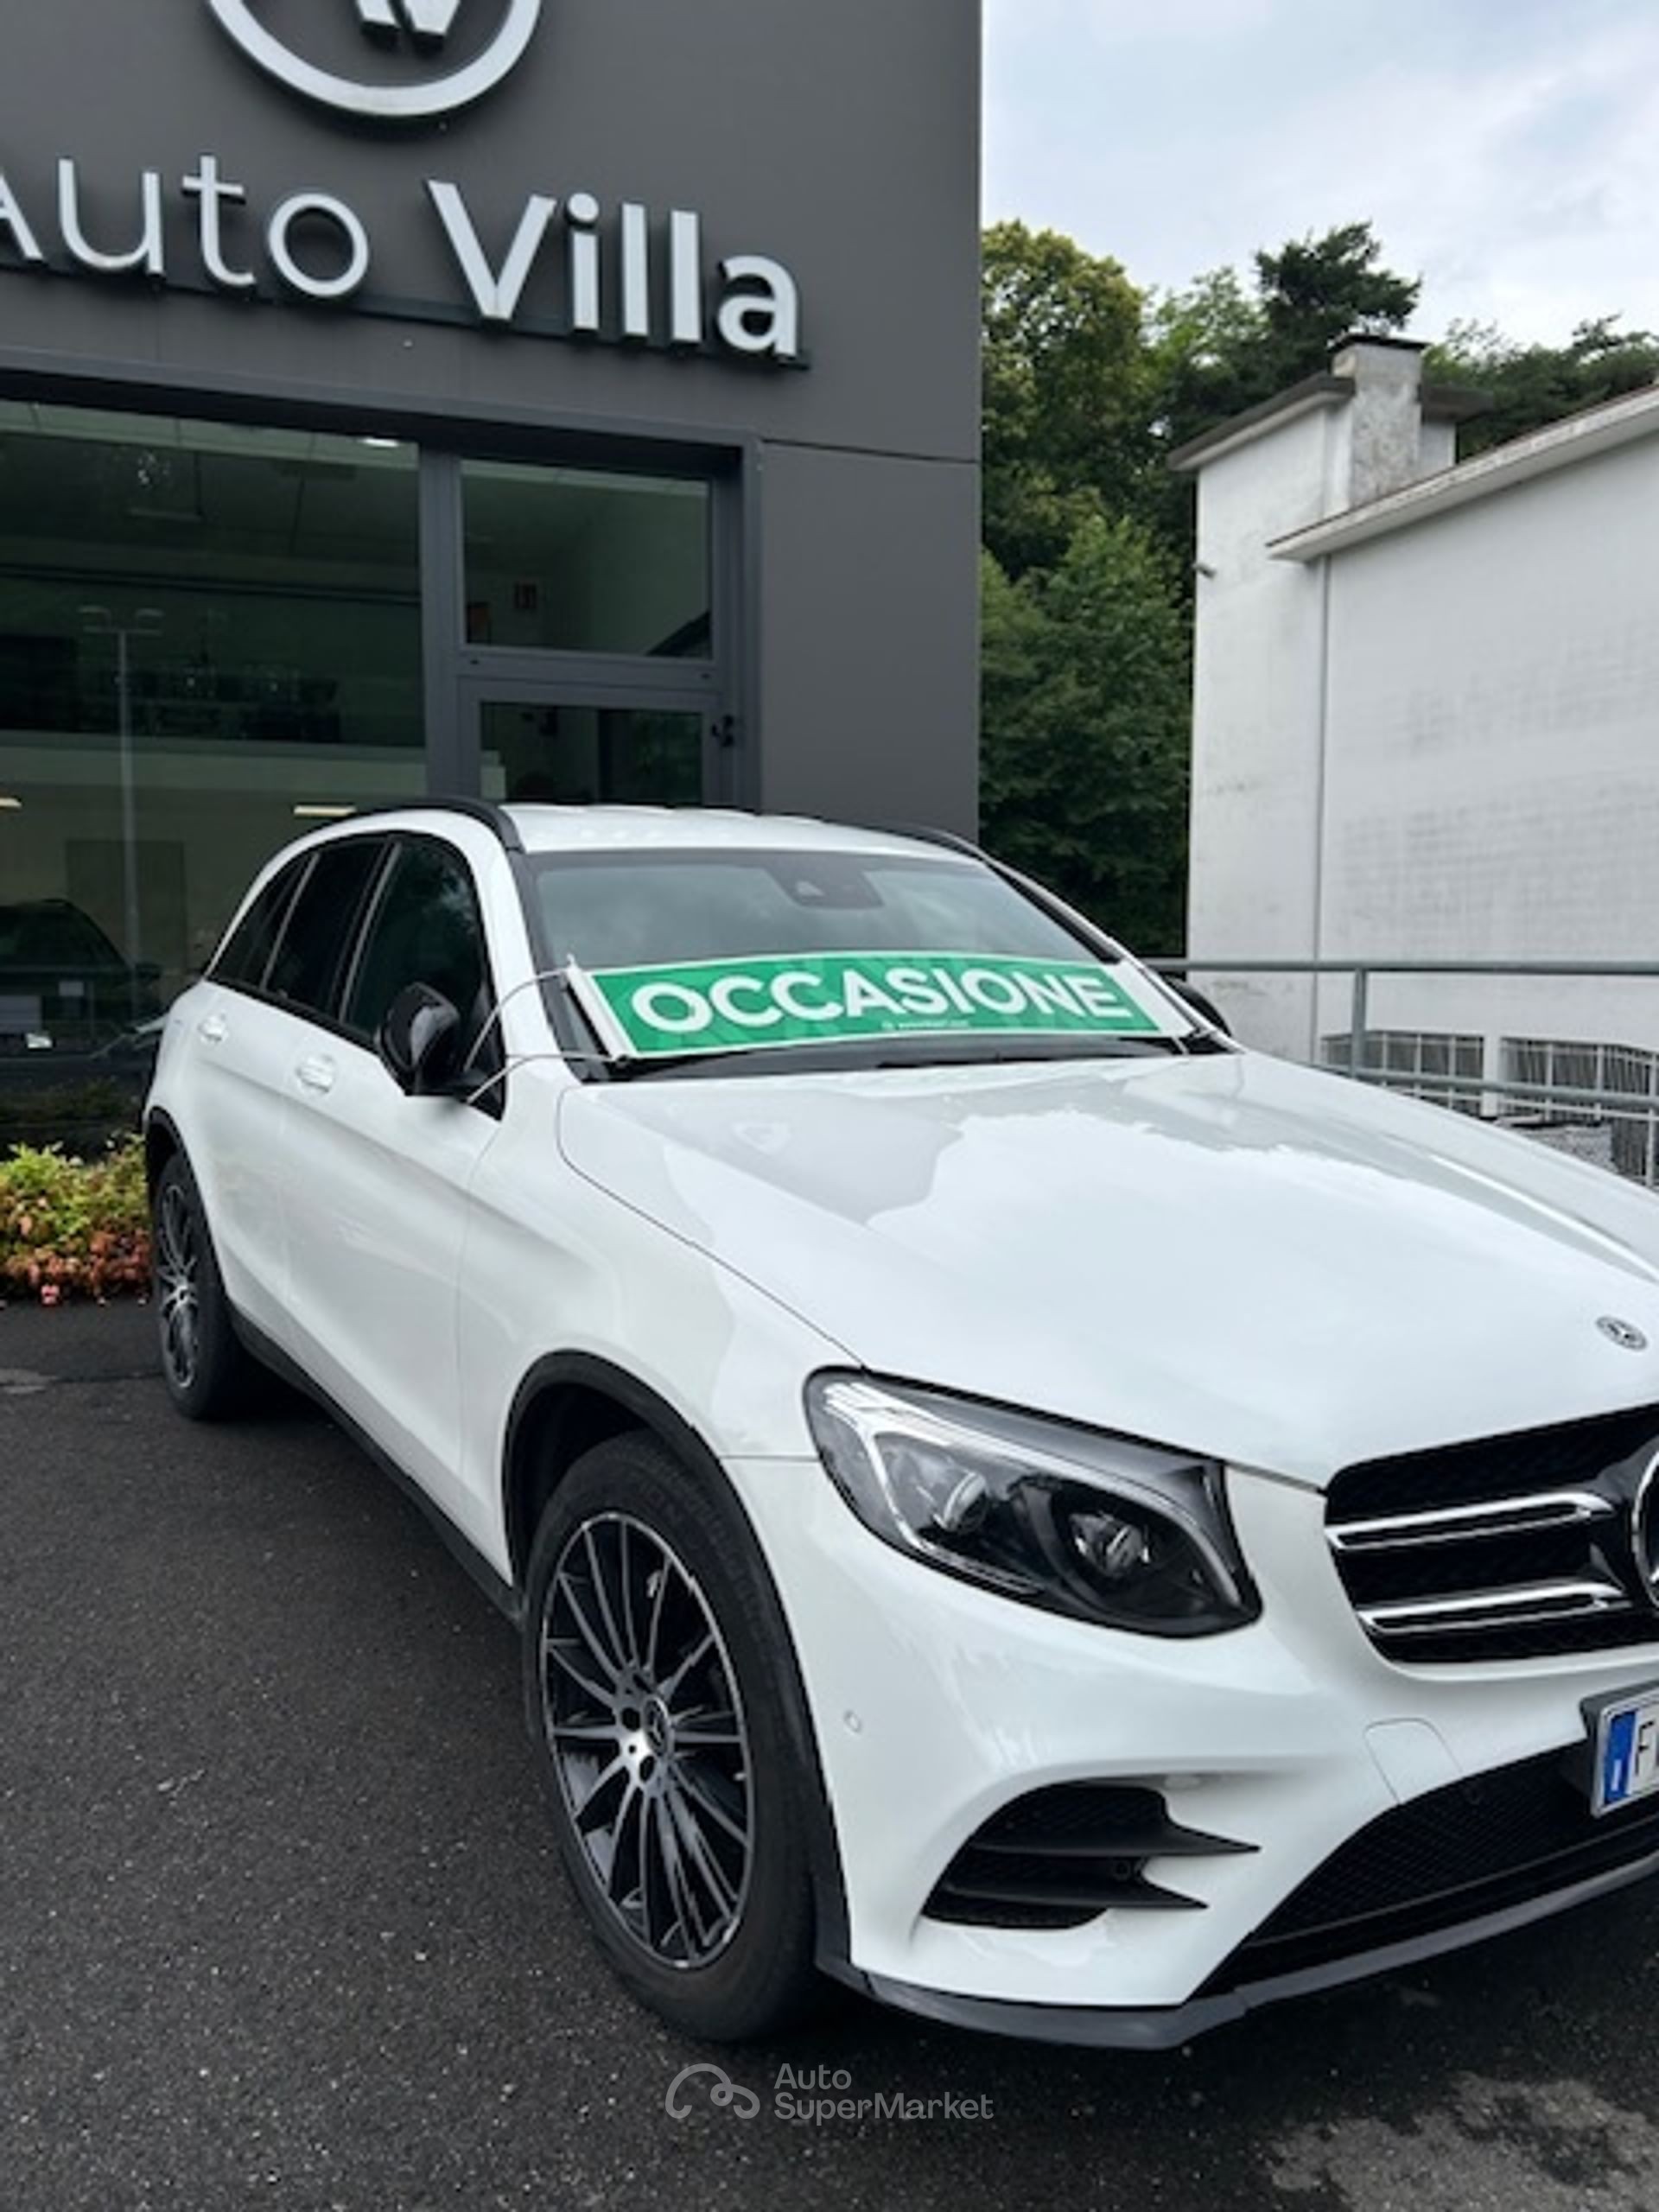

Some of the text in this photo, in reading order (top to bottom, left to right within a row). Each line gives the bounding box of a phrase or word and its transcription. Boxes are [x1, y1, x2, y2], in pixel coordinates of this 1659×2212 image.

[426, 179, 799, 356] Villa
[631, 967, 1133, 1033] OCCASIONE
[1635, 1719, 1659, 1776] F
